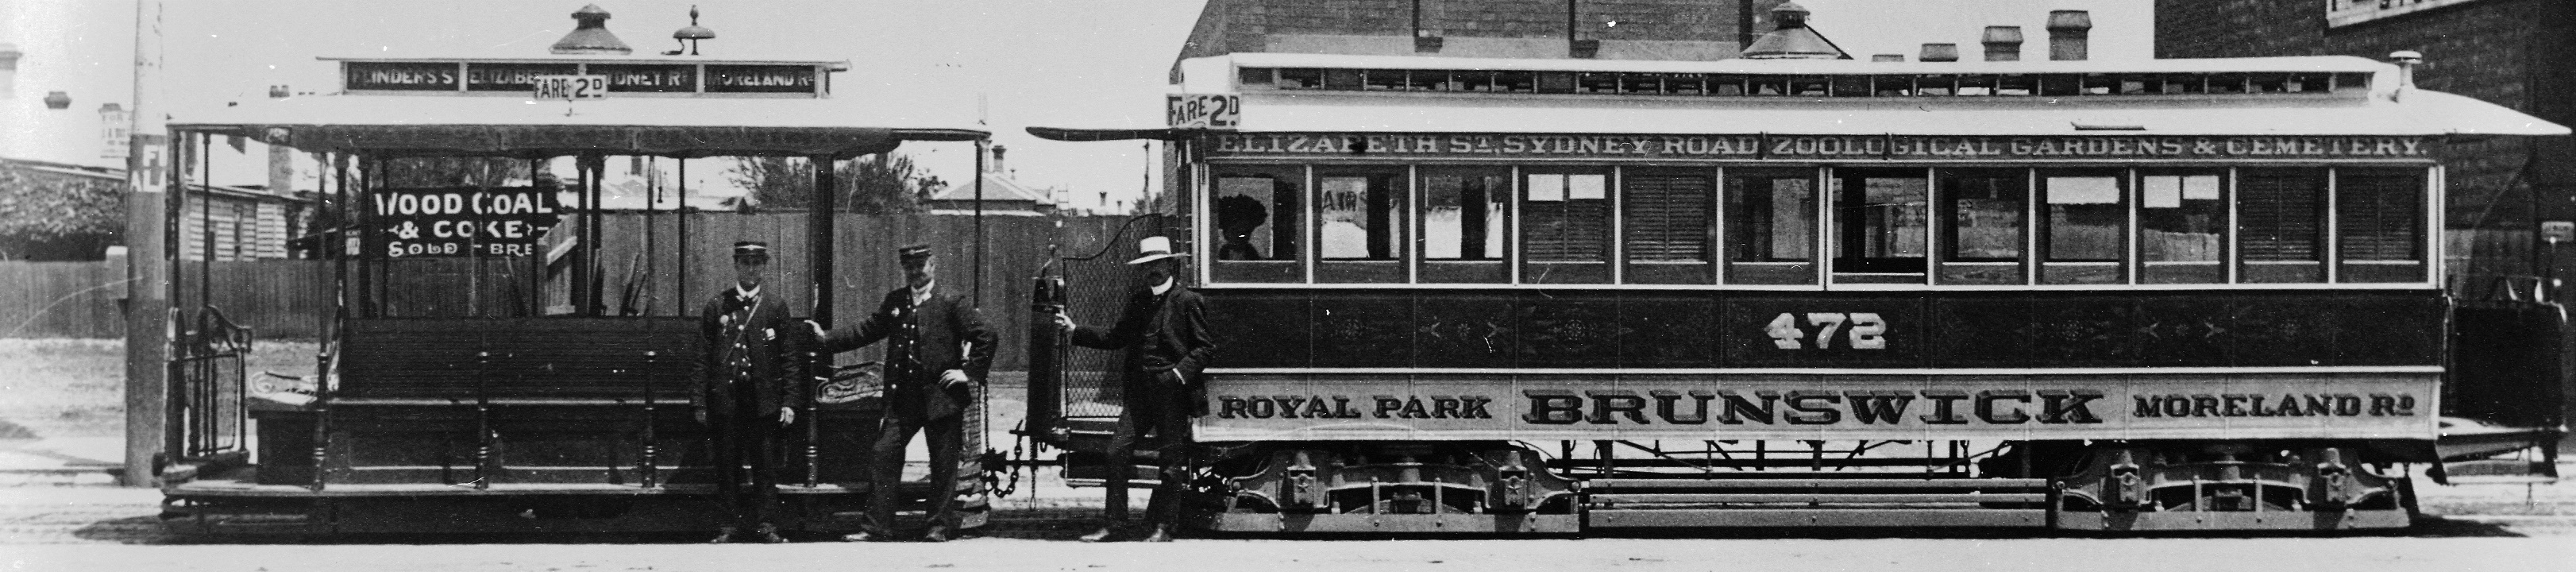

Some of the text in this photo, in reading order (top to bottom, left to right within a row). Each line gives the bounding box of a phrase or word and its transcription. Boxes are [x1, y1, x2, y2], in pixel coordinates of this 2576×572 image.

[534, 78, 569, 99] FARE
[1167, 95, 1208, 126] FARE
[1503, 135, 1651, 154] SYDNEY
[1661, 137, 1759, 155] ROAD
[1772, 137, 2001, 156] ZOOLOGICAL
[2011, 137, 2184, 156] GARDENS
[2193, 137, 2217, 156] &
[375, 192, 553, 216] WOOD COAL
[398, 220, 523, 240] & COKE
[388, 241, 458, 257] SOLD
[1764, 312, 1887, 350] 472
[1217, 395, 1362, 419] ROYAL
[1371, 395, 1493, 419] PARK
[1521, 389, 2104, 425] BRUNSWICK
[2132, 393, 2362, 418] MORELAND
